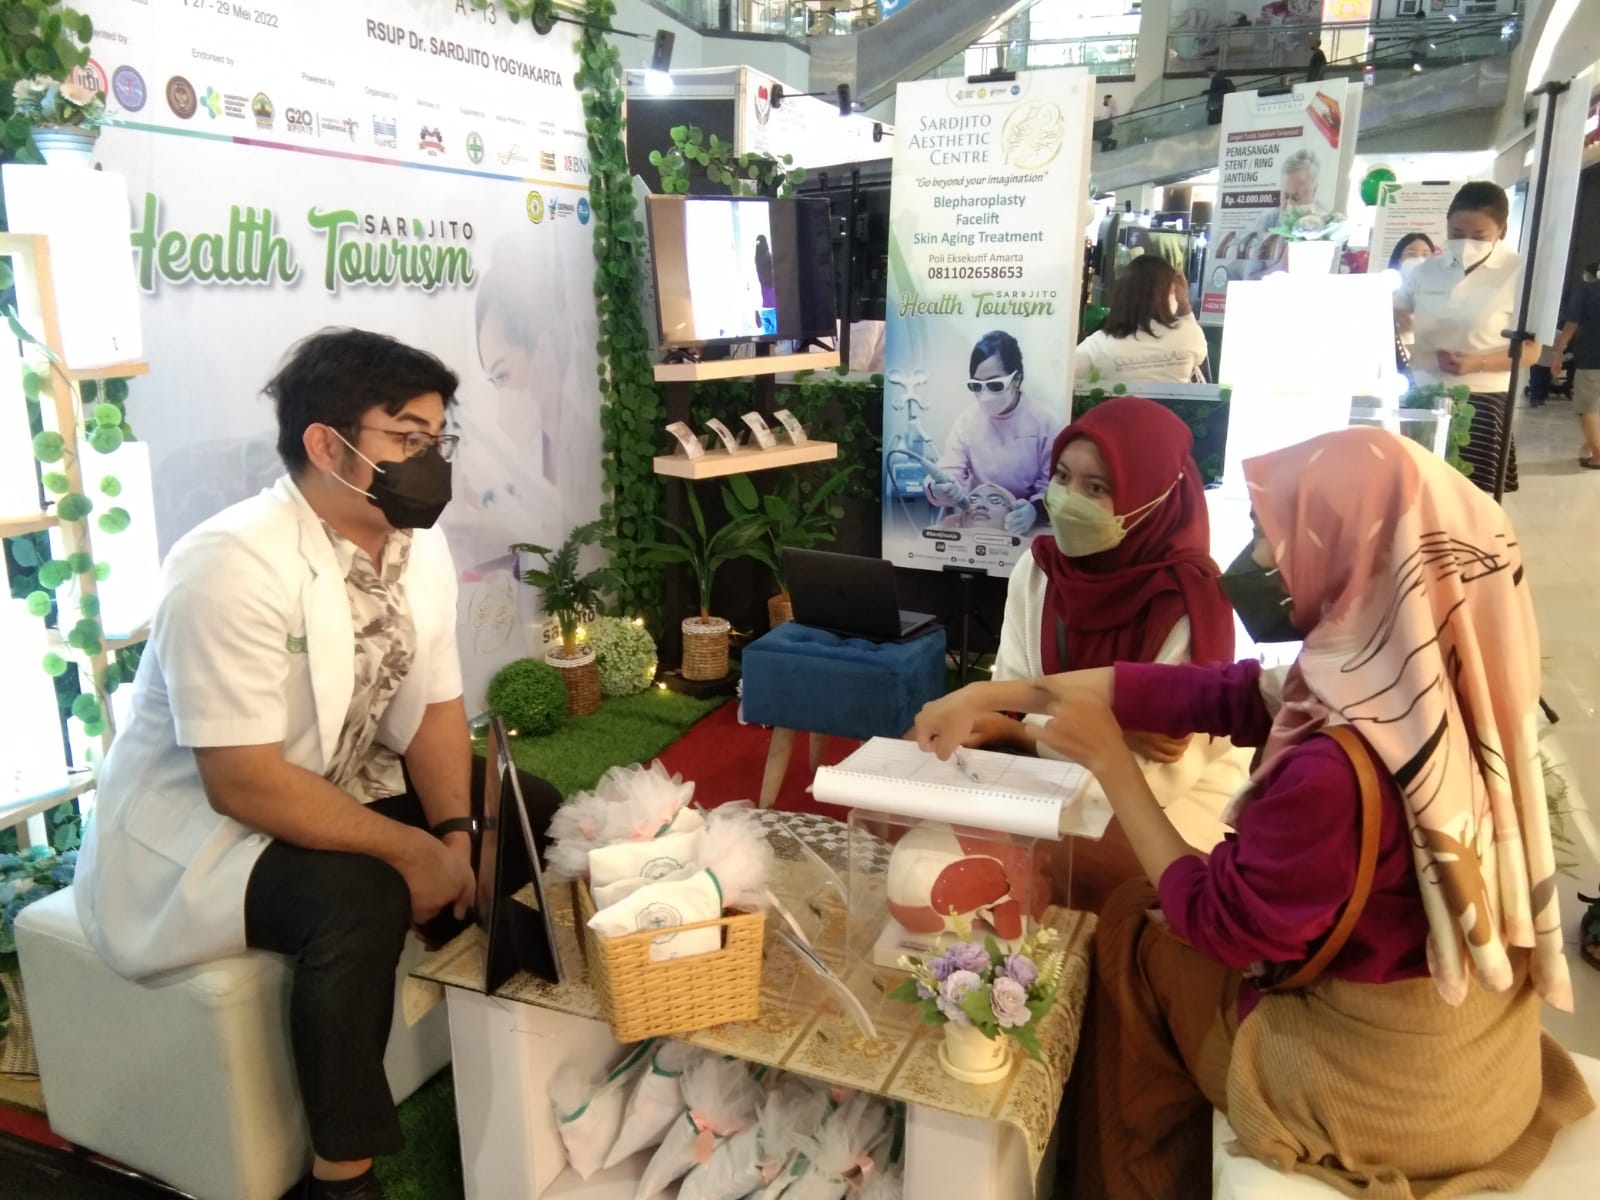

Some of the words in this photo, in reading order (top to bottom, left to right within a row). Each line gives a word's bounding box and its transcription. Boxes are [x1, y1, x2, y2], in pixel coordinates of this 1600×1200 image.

[217, 1, 230, 16] 29
[232, 4, 252, 21] Mei
[254, 10, 279, 28] 2022
[482, 3, 497, 25] 13
[366, 18, 406, 46] RSUP
[409, 30, 427, 52] Dr.
[430, 37, 490, 69] SARDJITO
[492, 54, 563, 88] YOGYAKARTA
[285, 107, 313, 127] G20
[920, 114, 992, 132] SARDJITO
[908, 132, 990, 149] AESTHETIC
[930, 150, 990, 166] CENTRE
[1226, 144, 1280, 157] PEMASANGAN
[1224, 159, 1248, 170] STENT
[1254, 158, 1274, 168] RING
[932, 175, 964, 189] beyond
[965, 175, 987, 187] your
[1224, 172, 1258, 183] JANTUNG
[934, 194, 1026, 209] Blepharoplasty
[956, 212, 1000, 225] Facelift
[914, 232, 938, 244] Skin
[941, 231, 975, 246] Aging
[978, 231, 1043, 243] Treatment
[307, 206, 475, 291] Tourism
[929, 254, 945, 264] Poli
[947, 253, 987, 263] Eksekutif
[989, 253, 1024, 263] Amarta
[928, 266, 1024, 279] 081102658653
[899, 293, 965, 318] Health
[971, 290, 1057, 318] Tourism
